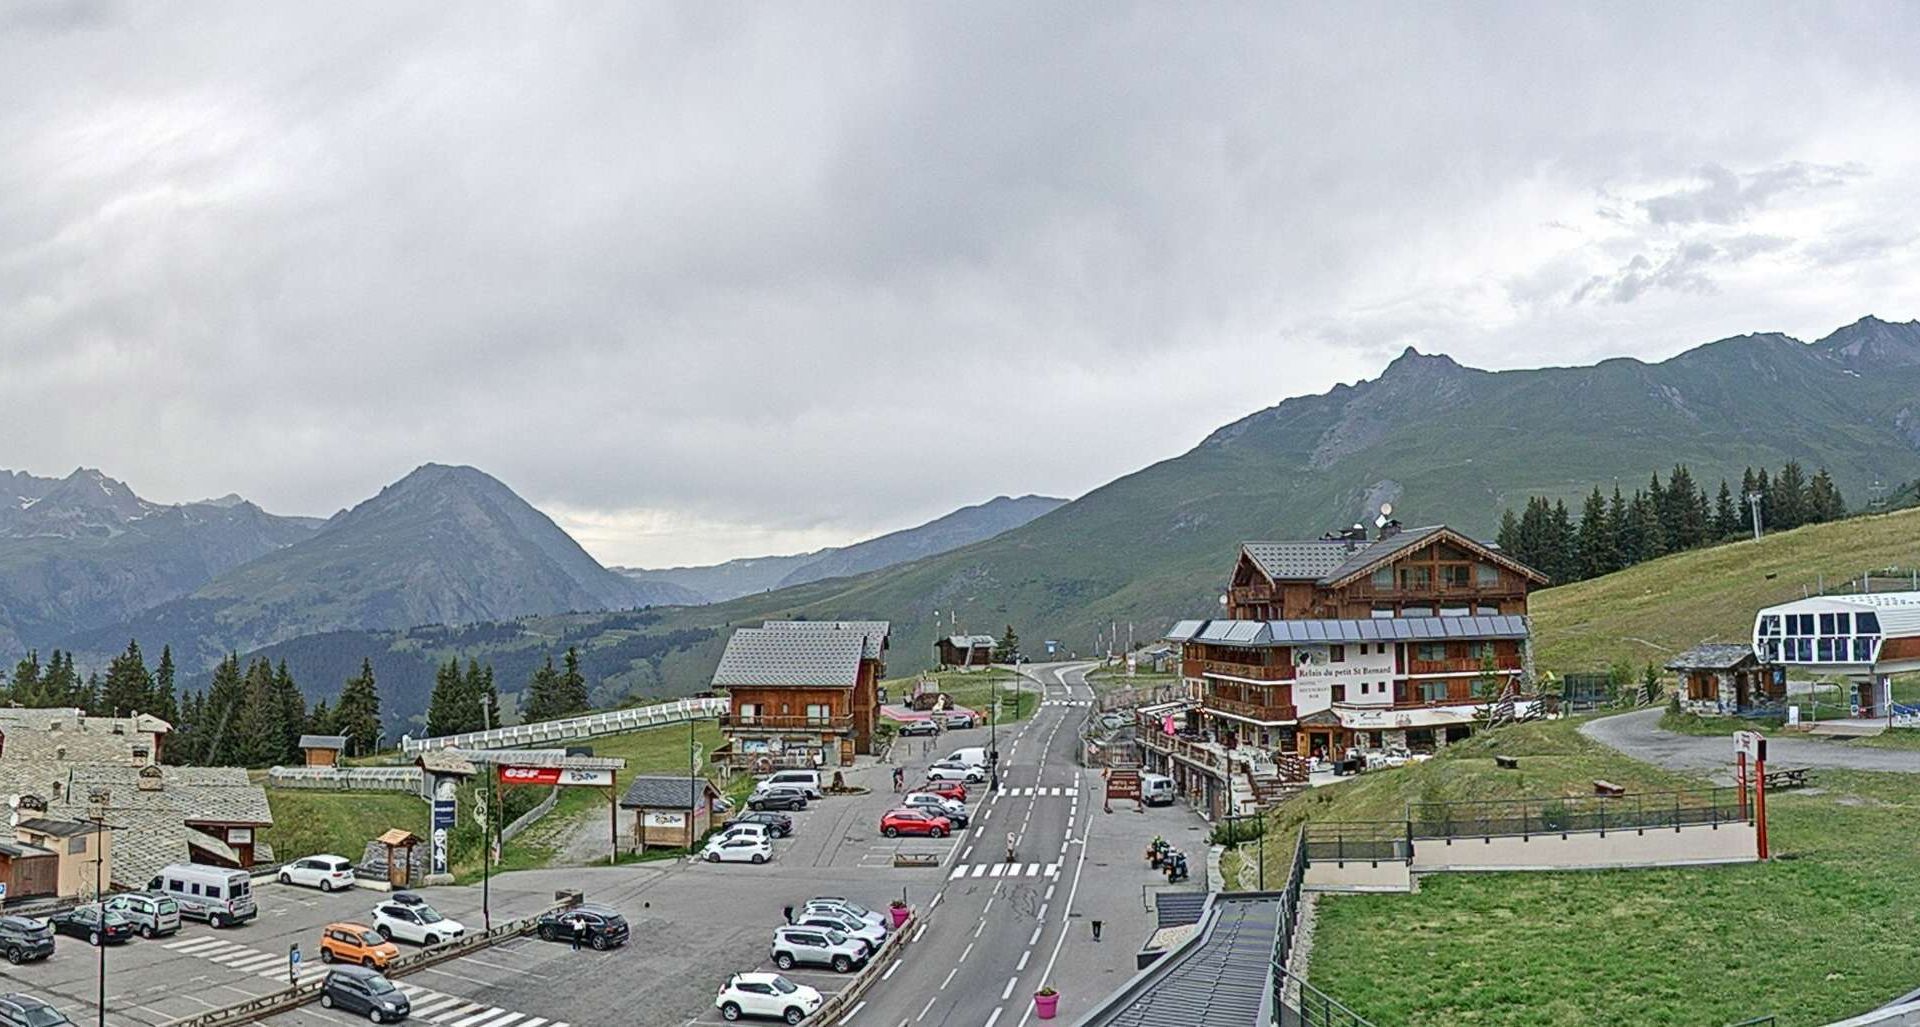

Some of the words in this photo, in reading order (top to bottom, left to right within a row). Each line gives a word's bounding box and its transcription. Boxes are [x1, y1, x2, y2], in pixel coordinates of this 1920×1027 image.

[1299, 669, 1322, 677] Relais
[1324, 668, 1333, 676] du
[1335, 668, 1351, 677] petit
[1353, 667, 1361, 675] St
[1363, 666, 1391, 675] Bernard
